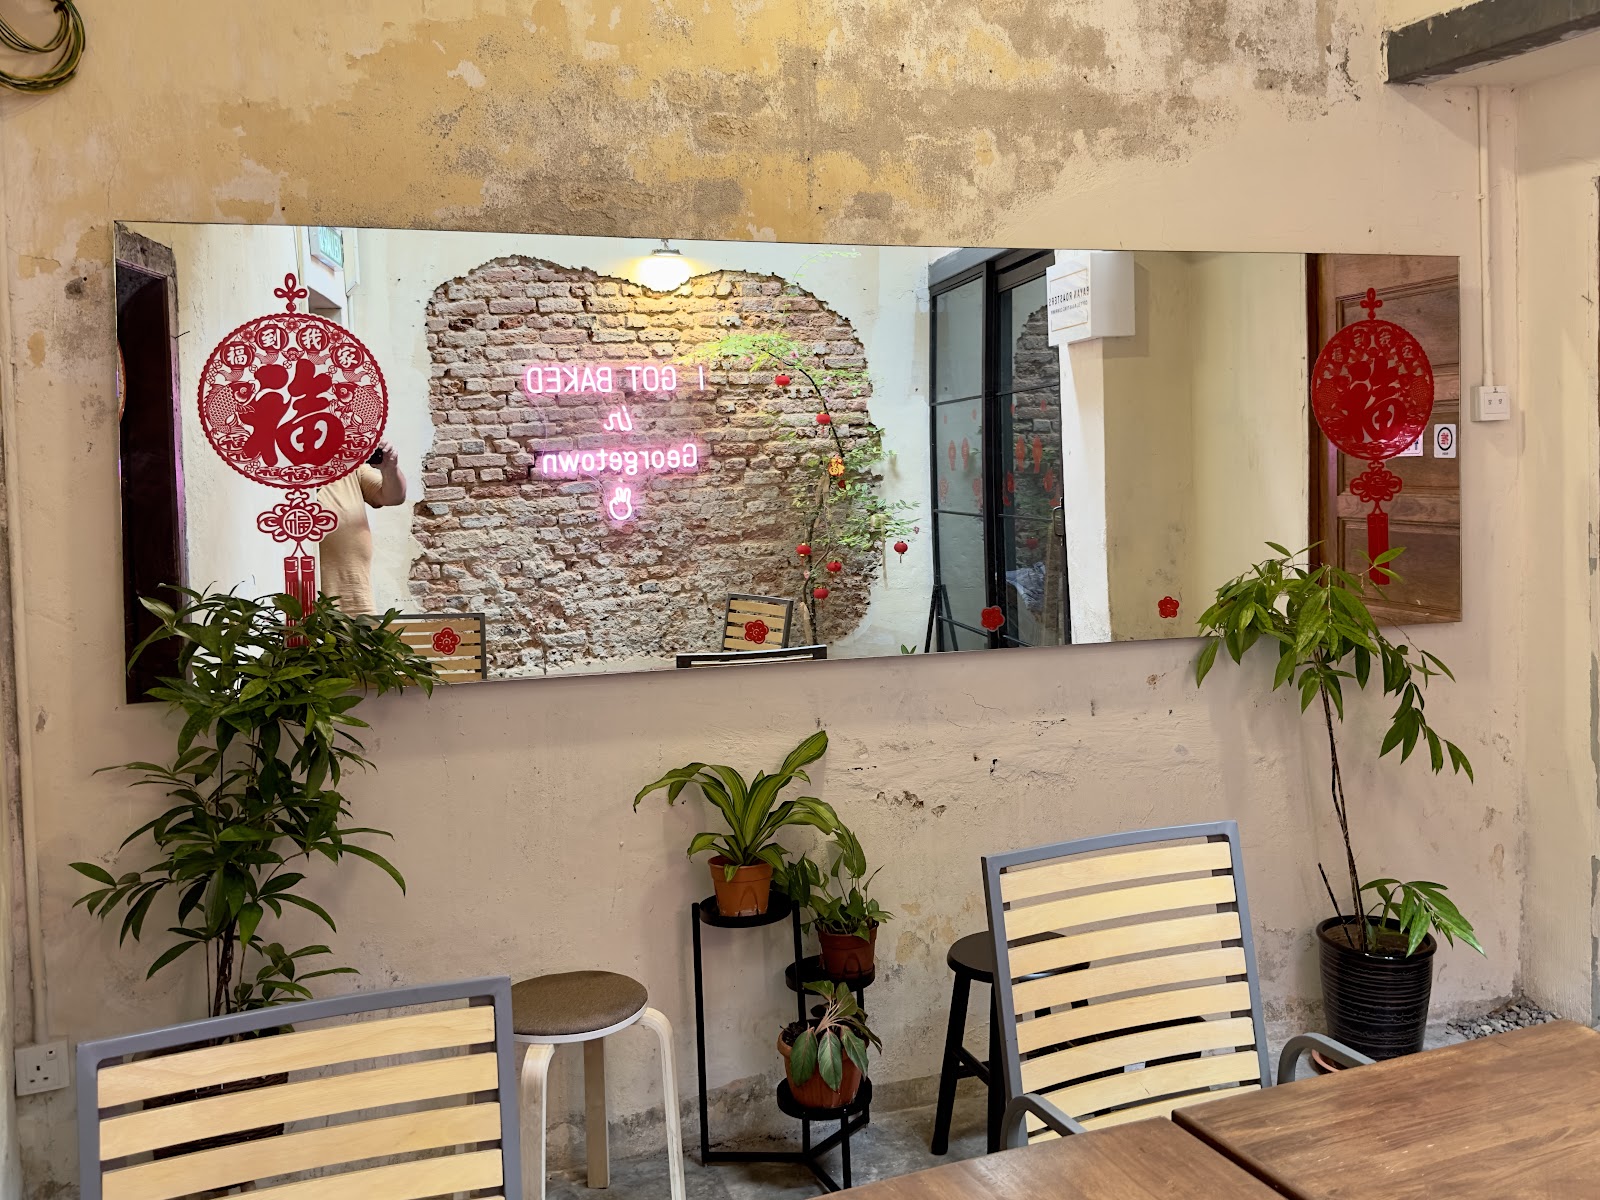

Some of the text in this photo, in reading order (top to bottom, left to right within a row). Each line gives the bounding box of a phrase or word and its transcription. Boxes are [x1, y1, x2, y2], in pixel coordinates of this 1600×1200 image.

[227, 327, 359, 366] 福到我家
[238, 358, 346, 467] 福
[283, 509, 313, 537] 福
